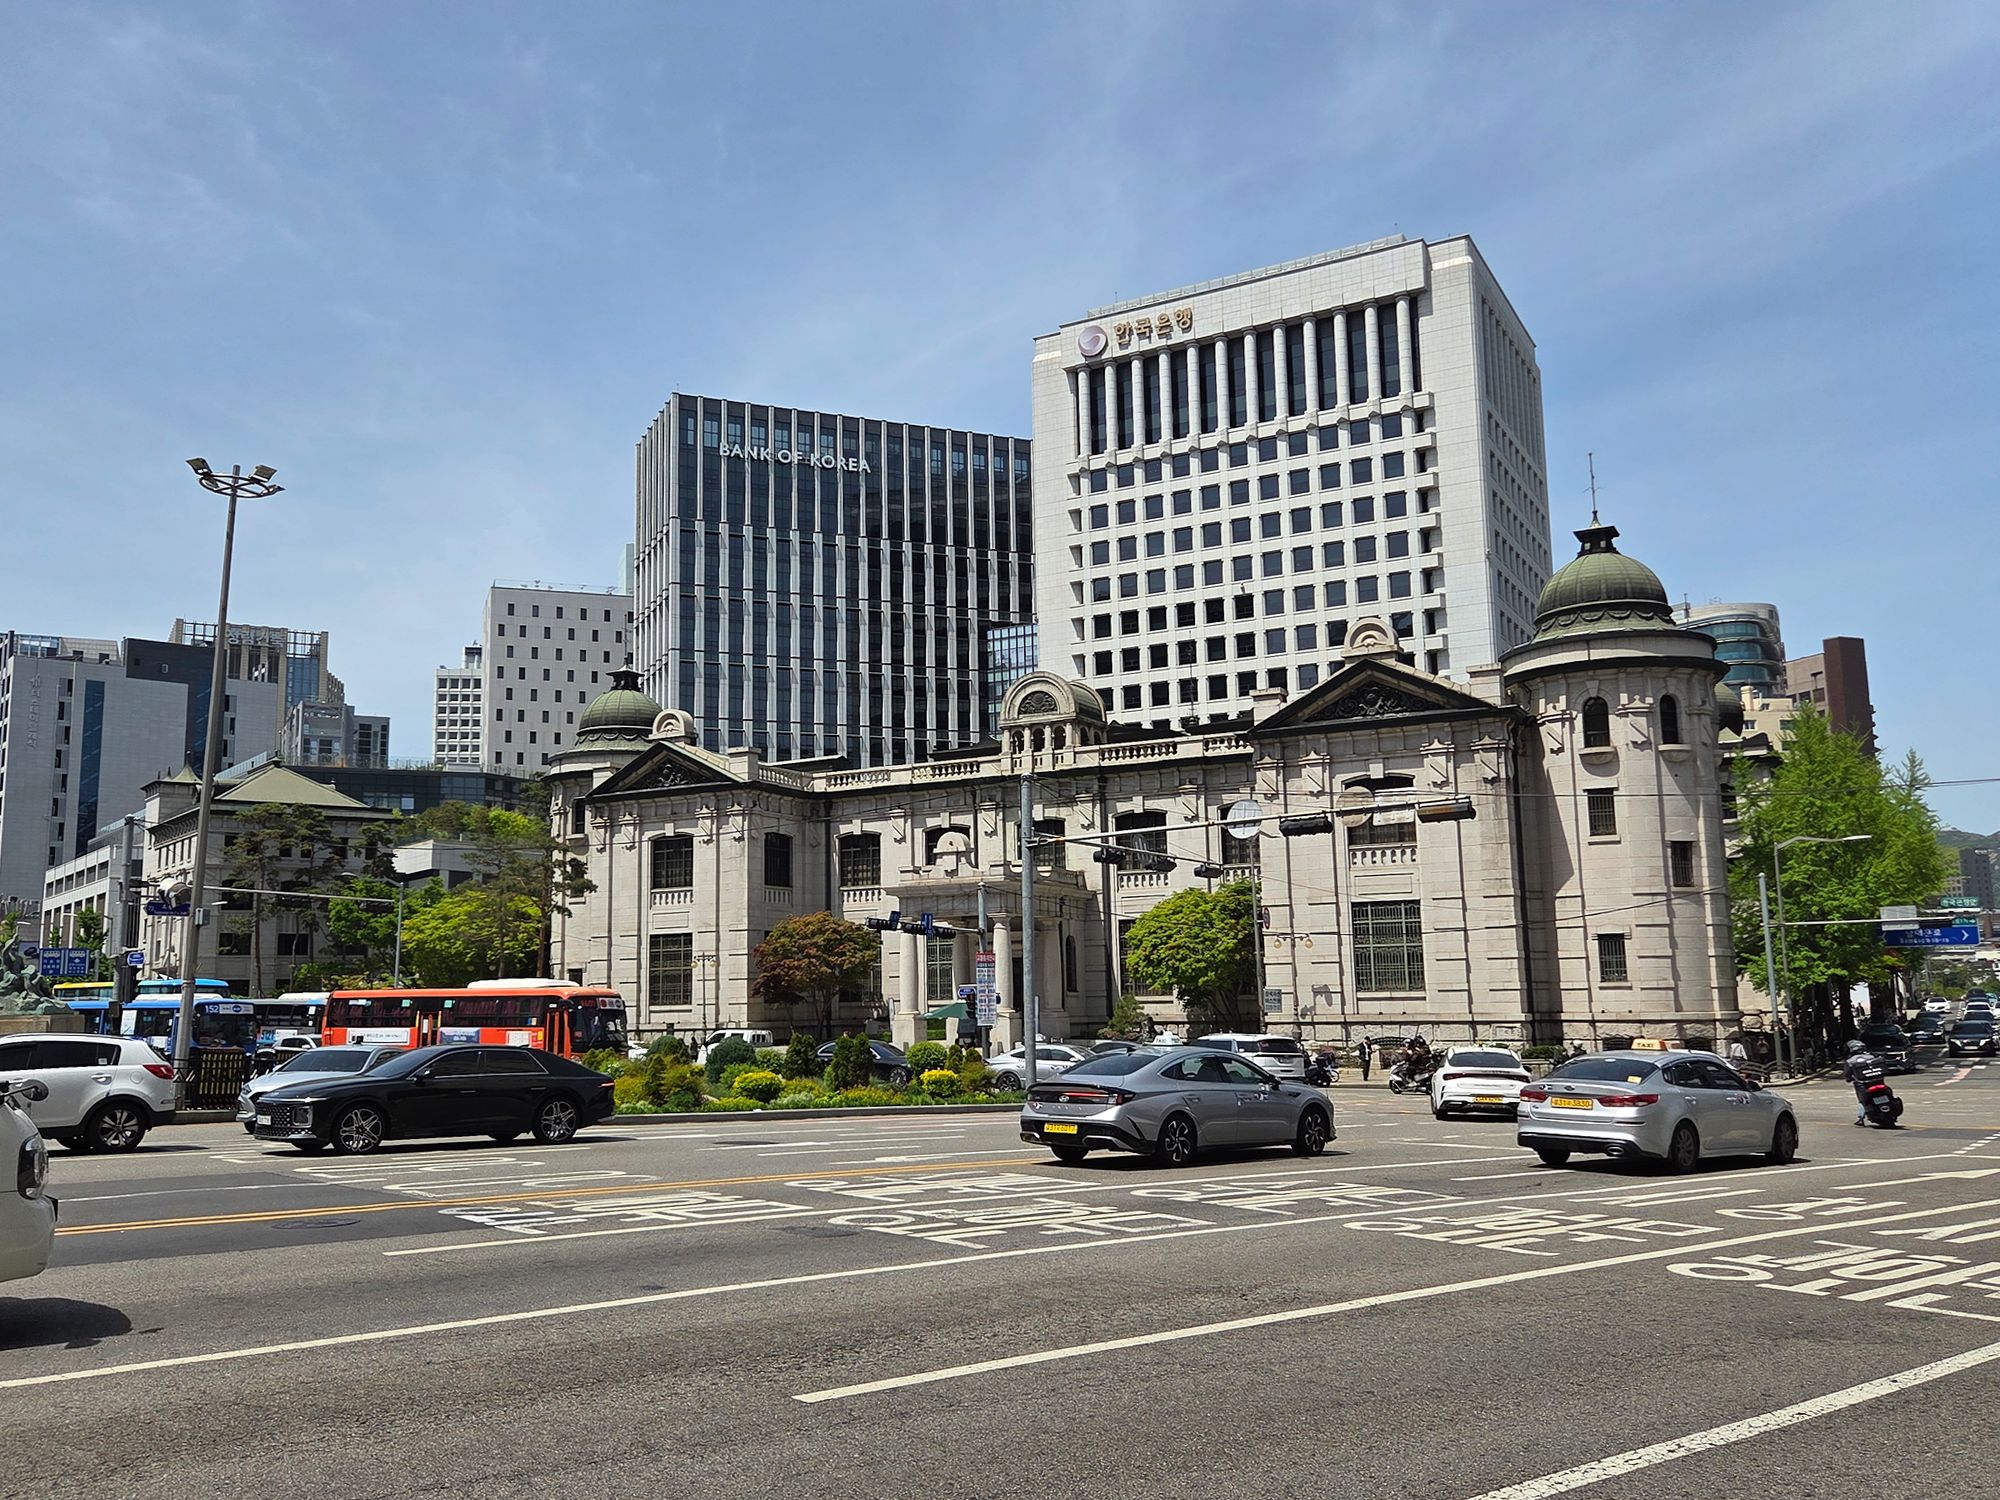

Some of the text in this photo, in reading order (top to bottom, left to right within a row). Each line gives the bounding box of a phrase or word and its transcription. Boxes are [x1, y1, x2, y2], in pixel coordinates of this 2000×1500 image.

[1113, 307, 1193, 345] 한국은행
[719, 441, 872, 474] BANK OF KOREA
[204, 1004, 219, 1014] 152
[437, 1190, 815, 1235] 광화문
[1129, 1179, 1466, 1215] 숭례문
[1567, 1185, 1908, 1221] 시청
[827, 1198, 1218, 1250] 광화문
[1341, 1205, 1725, 1257] 광화문
